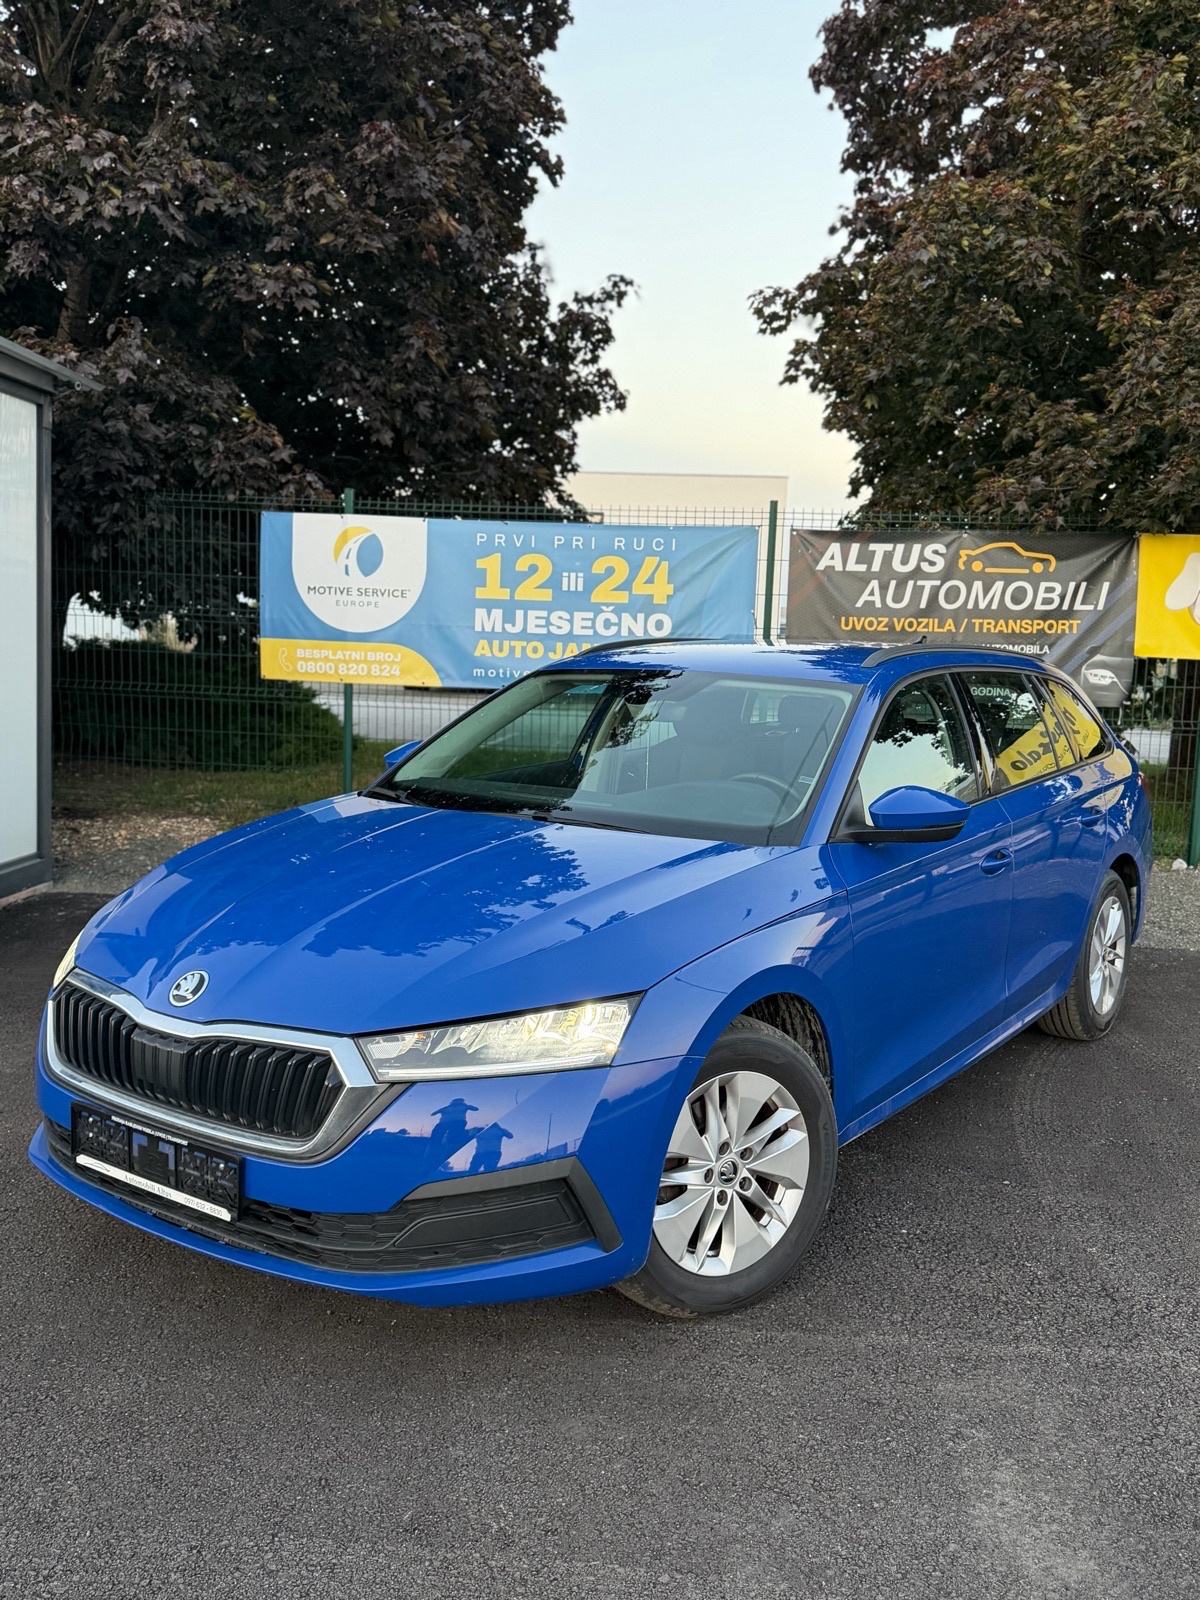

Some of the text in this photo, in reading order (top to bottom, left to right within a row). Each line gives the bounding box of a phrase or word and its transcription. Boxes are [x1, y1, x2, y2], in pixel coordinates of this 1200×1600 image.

[476, 533, 676, 551] PRVI PRI RUCI
[815, 542, 947, 573] ALTUS
[475, 552, 674, 604] 12 ili 24
[307, 585, 408, 598] MOTIVE SERVICE
[855, 579, 1110, 611] AUTOMOBILI
[336, 600, 380, 608] EUROPE
[474, 605, 673, 637] MJESEČNO
[840, 616, 889, 631] UVOZ
[893, 617, 956, 632] VOZILA
[972, 619, 1081, 634] TRANSPORT
[296, 648, 401, 662] BESPLATNI BROJ
[474, 639, 545, 659] AUTO
[297, 661, 401, 677] 0800 820 824
